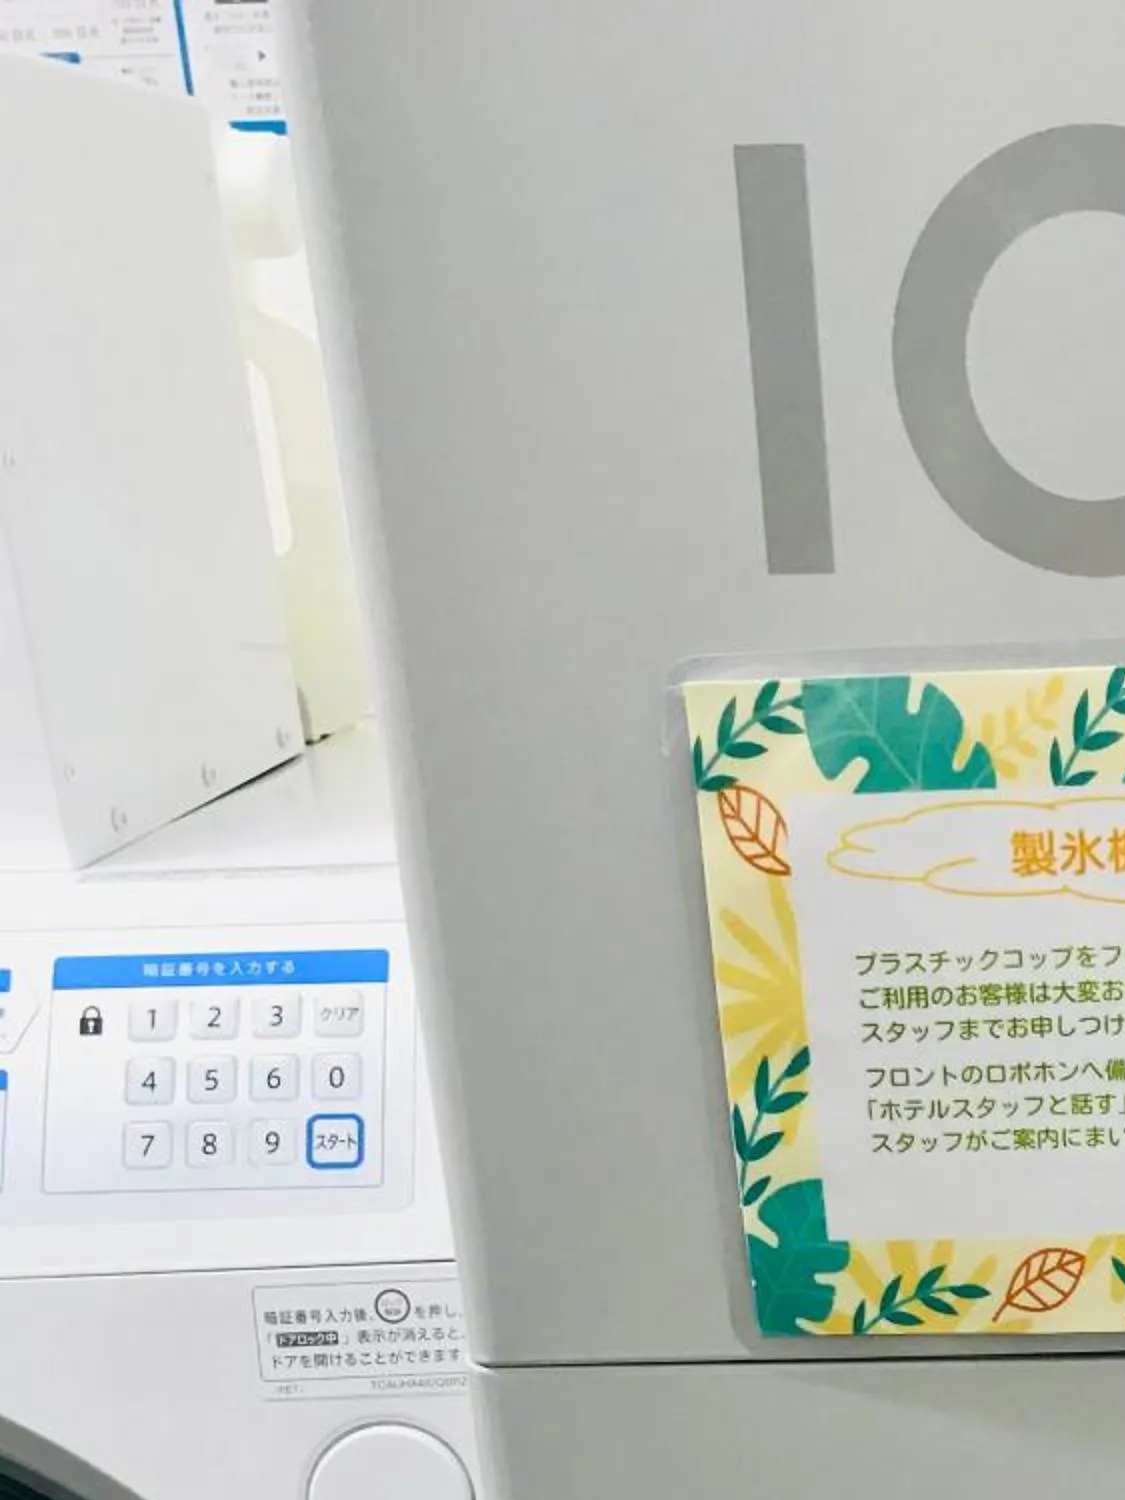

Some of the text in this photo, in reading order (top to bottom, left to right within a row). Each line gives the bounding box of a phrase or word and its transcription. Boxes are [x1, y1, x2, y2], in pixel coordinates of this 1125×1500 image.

[143, 960, 296, 978] 暗証番号を入力する
[147, 1009, 158, 1029] 1
[207, 1007, 222, 1028] 2
[271, 1005, 284, 1026] 3
[320, 1006, 360, 1022] クリア
[141, 1071, 157, 1093] 4
[204, 1069, 219, 1091] 5
[266, 1067, 282, 1089] 6
[328, 1066, 345, 1089] 0
[140, 1135, 155, 1157] 7
[202, 1133, 217, 1156] 8
[265, 1131, 280, 1154] 9
[315, 1133, 357, 1150] スタート
